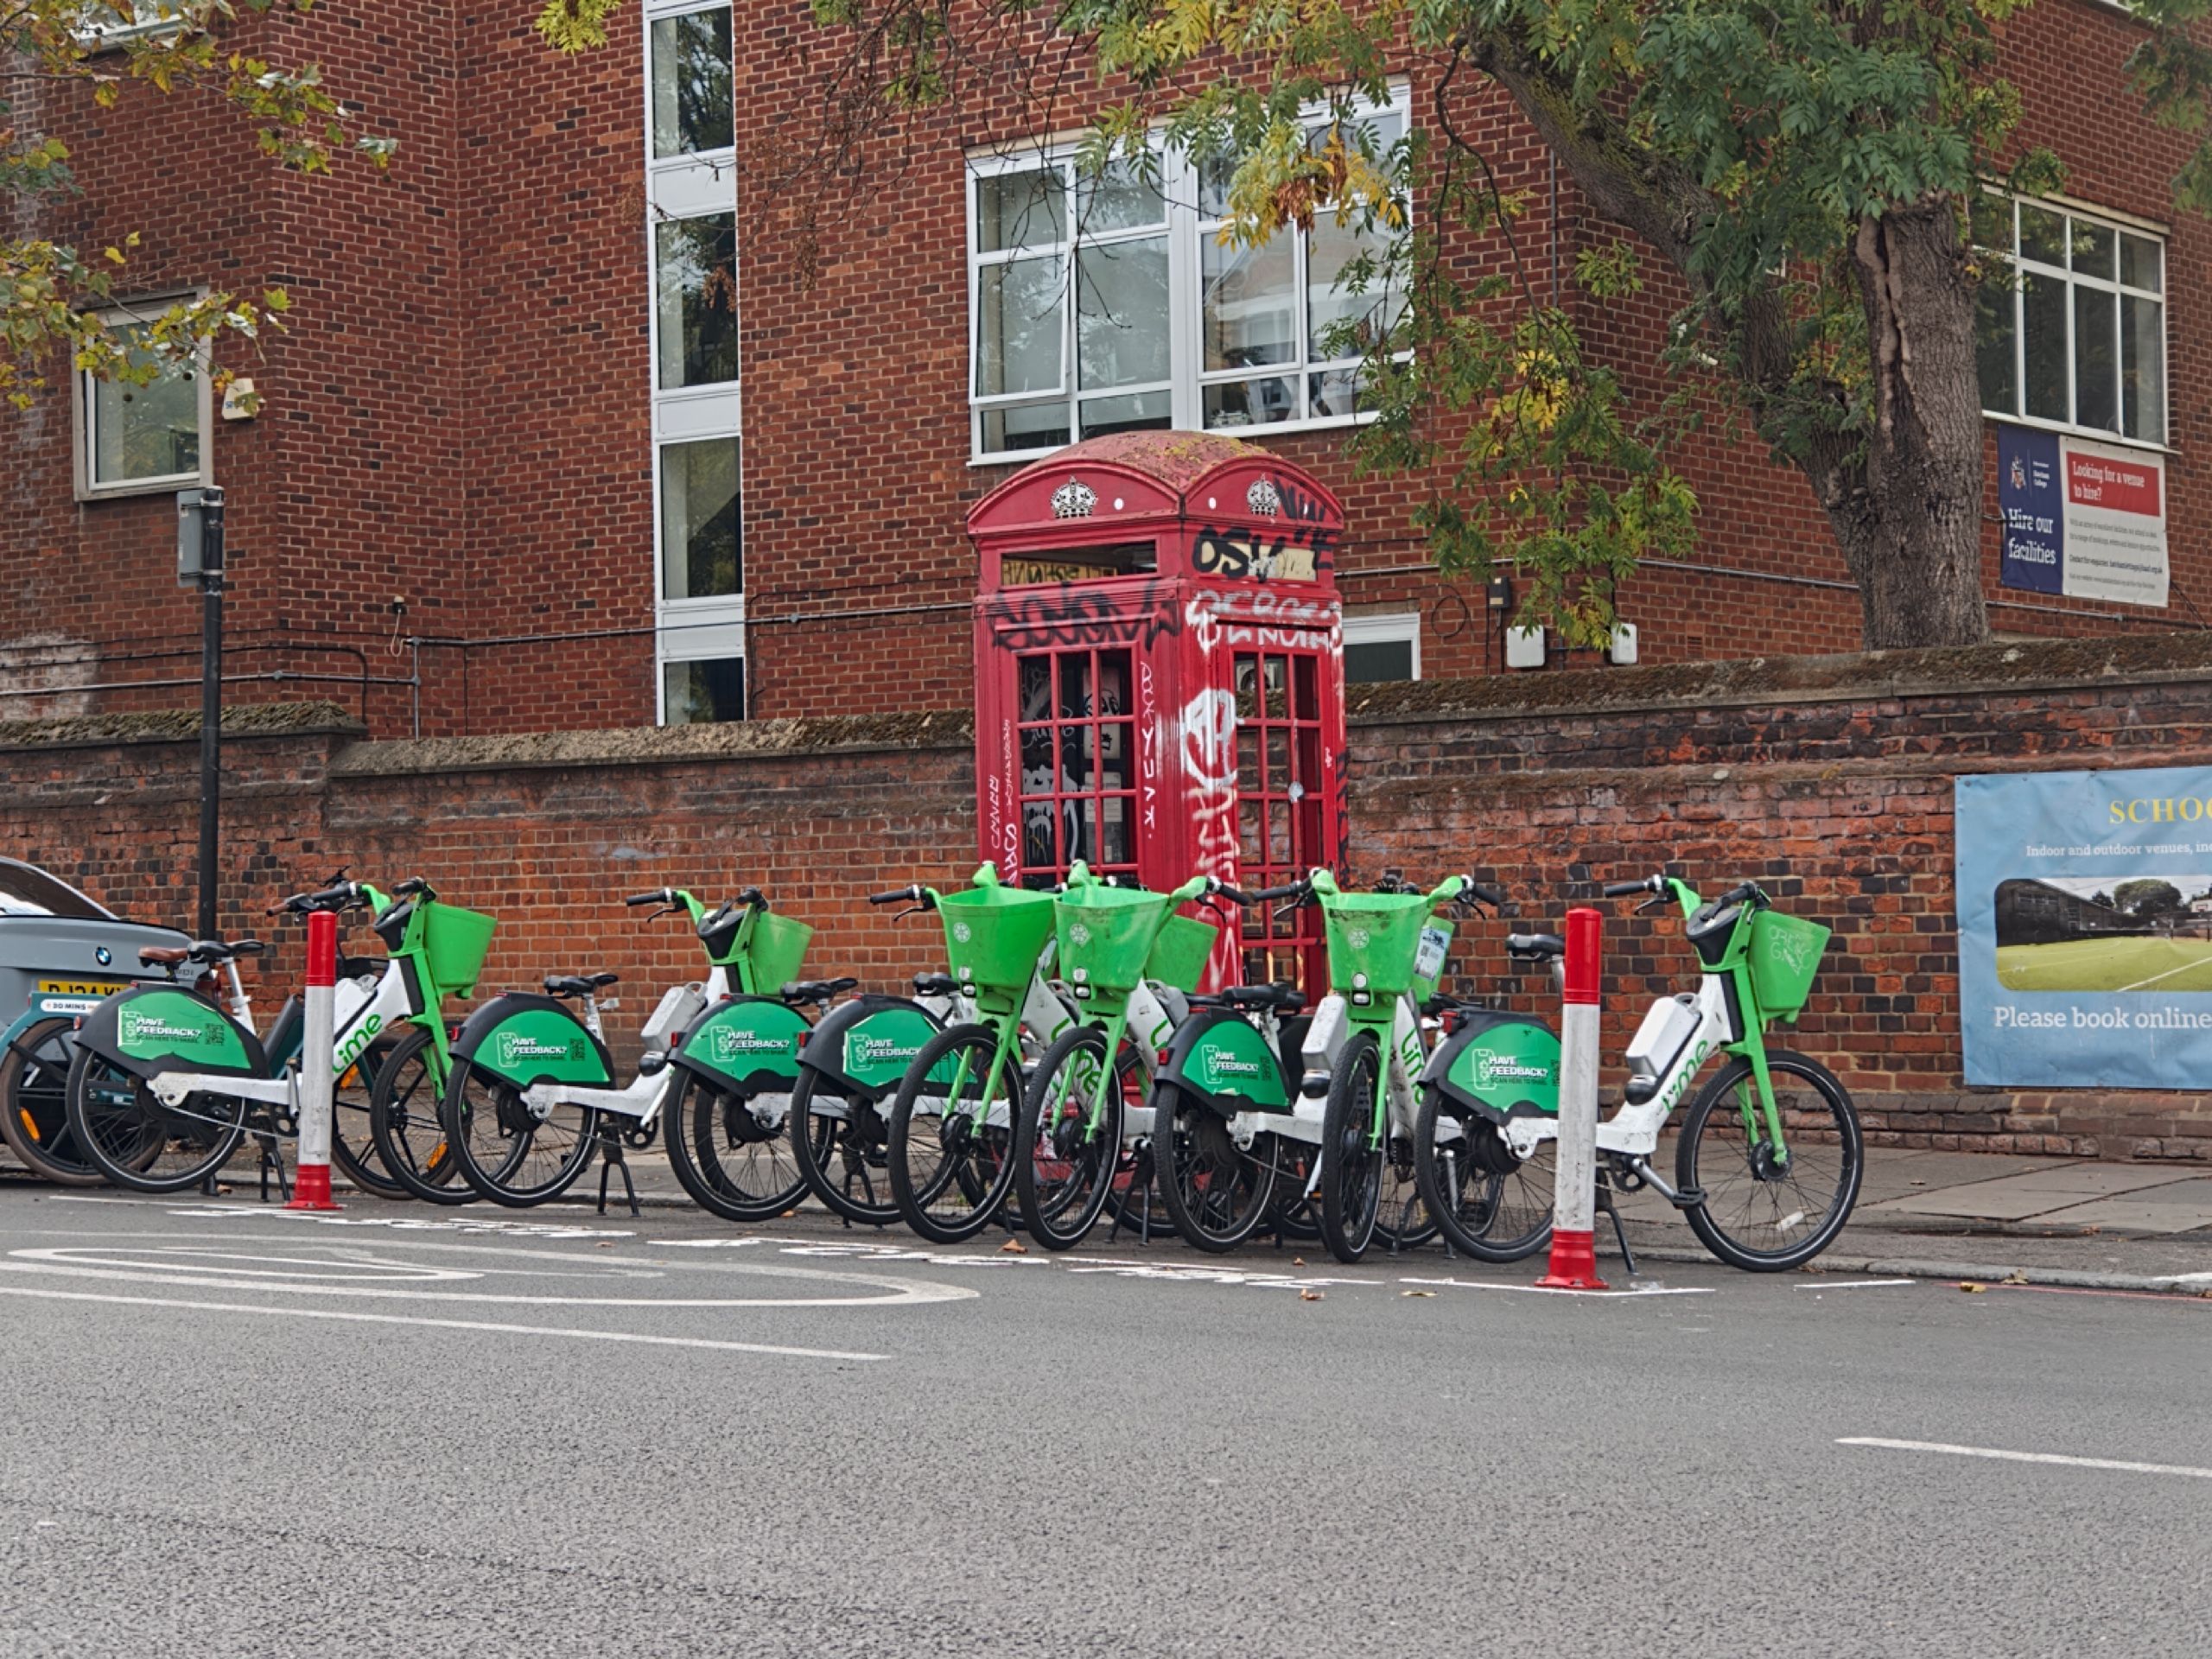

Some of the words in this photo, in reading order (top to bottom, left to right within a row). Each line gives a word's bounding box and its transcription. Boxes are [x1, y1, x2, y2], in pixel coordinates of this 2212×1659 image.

[2072, 461, 2102, 484] Looking
[2105, 466, 2115, 482] for
[2117, 472, 2123, 483] a
[2123, 473, 2145, 488] venue
[2074, 483, 2082, 498] to
[2082, 483, 2102, 501] hire?
[2008, 507, 2034, 531] Hire
[2036, 517, 2054, 534] our
[2008, 537, 2056, 565] facilities
[2109, 797, 2212, 824] SCHO
[2026, 845, 2065, 857] Indoor
[2068, 843, 2091, 856] and
[2094, 842, 2142, 855] outdoor
[2145, 842, 2193, 855] venues,
[137, 1018, 166, 1027] HAVE
[1993, 1006, 2067, 1028] Please
[2071, 1006, 2130, 1028] book
[2134, 1007, 2212, 1029] online
[137, 1027, 202, 1037] FEEDBACK?
[728, 1031, 756, 1039] HAVE
[512, 1038, 537, 1046] HAVE
[728, 1039, 790, 1049] FEEDBACK?
[866, 1039, 894, 1048] HAVE
[513, 1046, 567, 1055] FEEDBACK?
[1489, 1056, 1516, 1065] HAVE
[1490, 1066, 1548, 1077] FEEDBACK?
[1662, 1040, 1707, 1112] Lime
